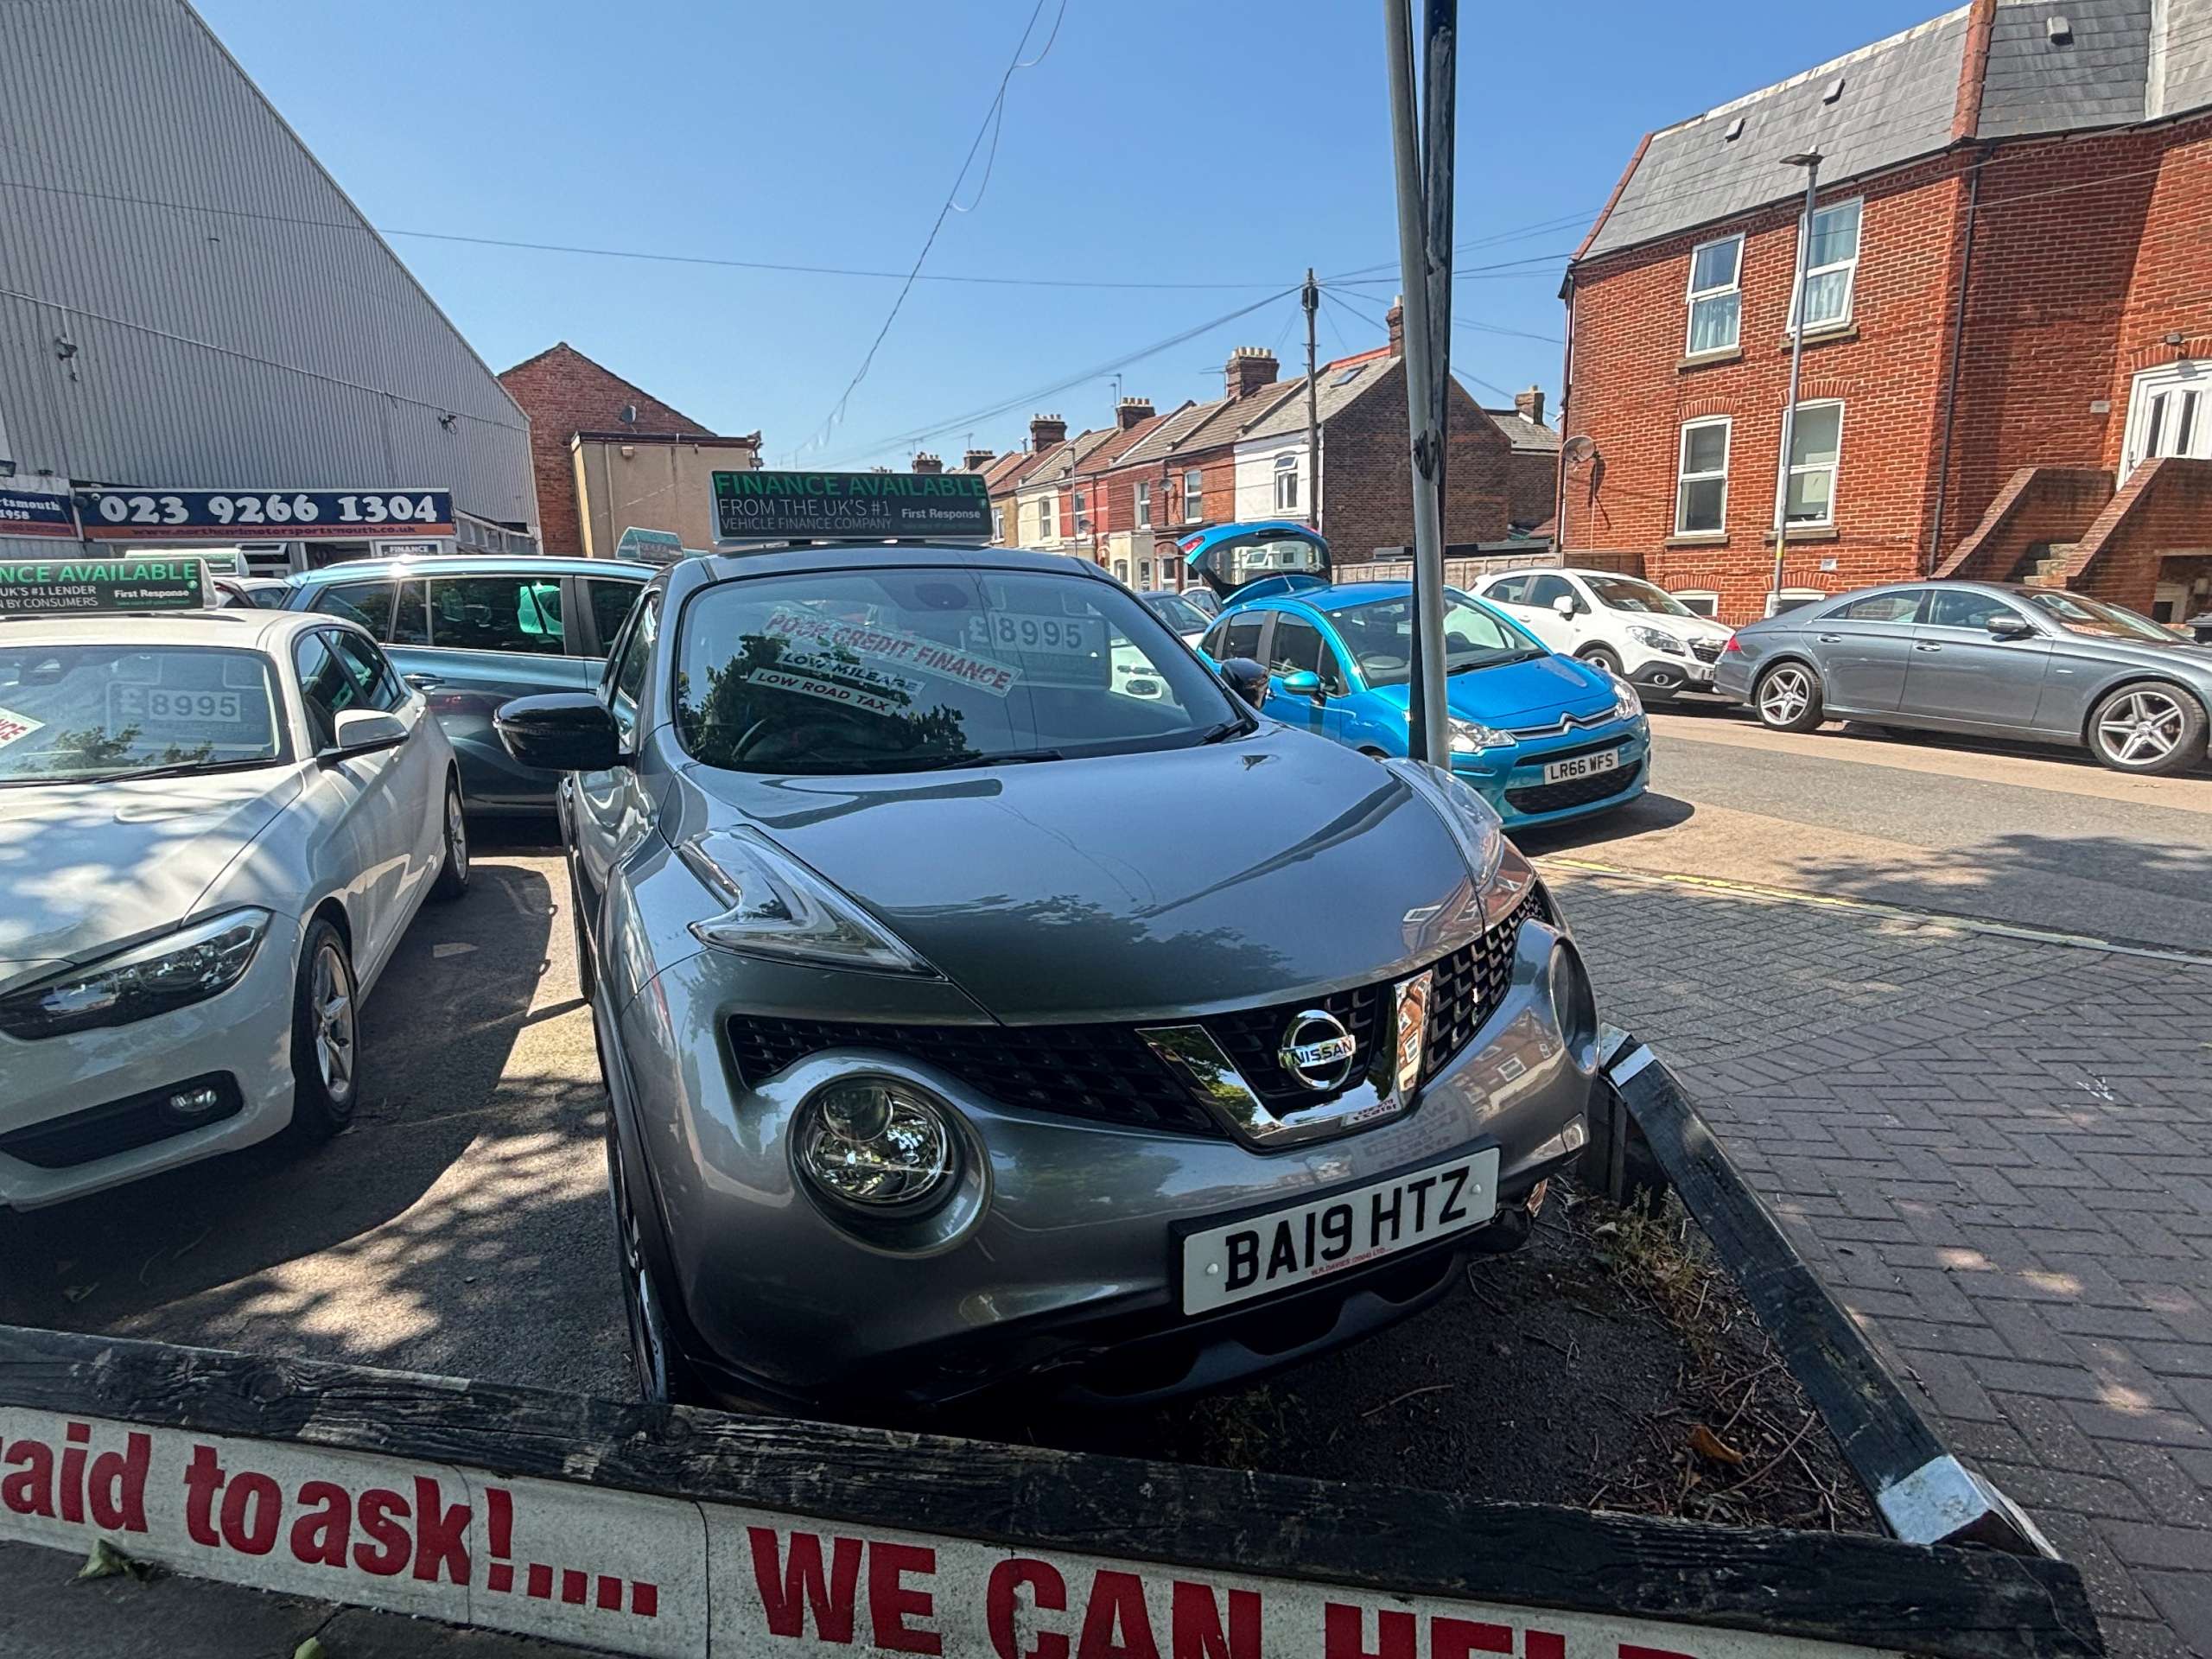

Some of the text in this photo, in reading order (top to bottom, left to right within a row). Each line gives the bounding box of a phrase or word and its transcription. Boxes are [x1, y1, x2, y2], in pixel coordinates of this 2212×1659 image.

[716, 474, 987, 497] FINANCE AVAILABLE
[0, 498, 60, 511] tsmouth
[0, 509, 30, 519] 1958
[99, 494, 437, 524] 023 9266 1304
[720, 499, 892, 516] FROM THE UK'S #1
[901, 508, 981, 520] First Response
[721, 518, 774, 531] VEHICLE
[778, 518, 832, 531] FINANCE
[834, 518, 892, 531] COMPANY
[58, 563, 196, 582] AVAILABLE
[31, 587, 46, 596] #1
[48, 585, 96, 596] LENDER
[114, 588, 189, 600] First Response
[23, 596, 99, 608] CONSUMERS
[766, 614, 830, 638] POOR
[833, 627, 916, 658] CREDIT
[912, 646, 1012, 690] FINANCE
[757, 672, 891, 712] LOW ROAD TAX
[1550, 753, 1613, 779] LR66 WFS
[1291, 1039, 1353, 1064] NISSAN
[1224, 1166, 1471, 1292] BA19 HTZ
[0, 1422, 151, 1533] aid
[184, 1445, 282, 1555] to
[747, 1527, 942, 1656] WE
[987, 1559, 1262, 1659] CAN
